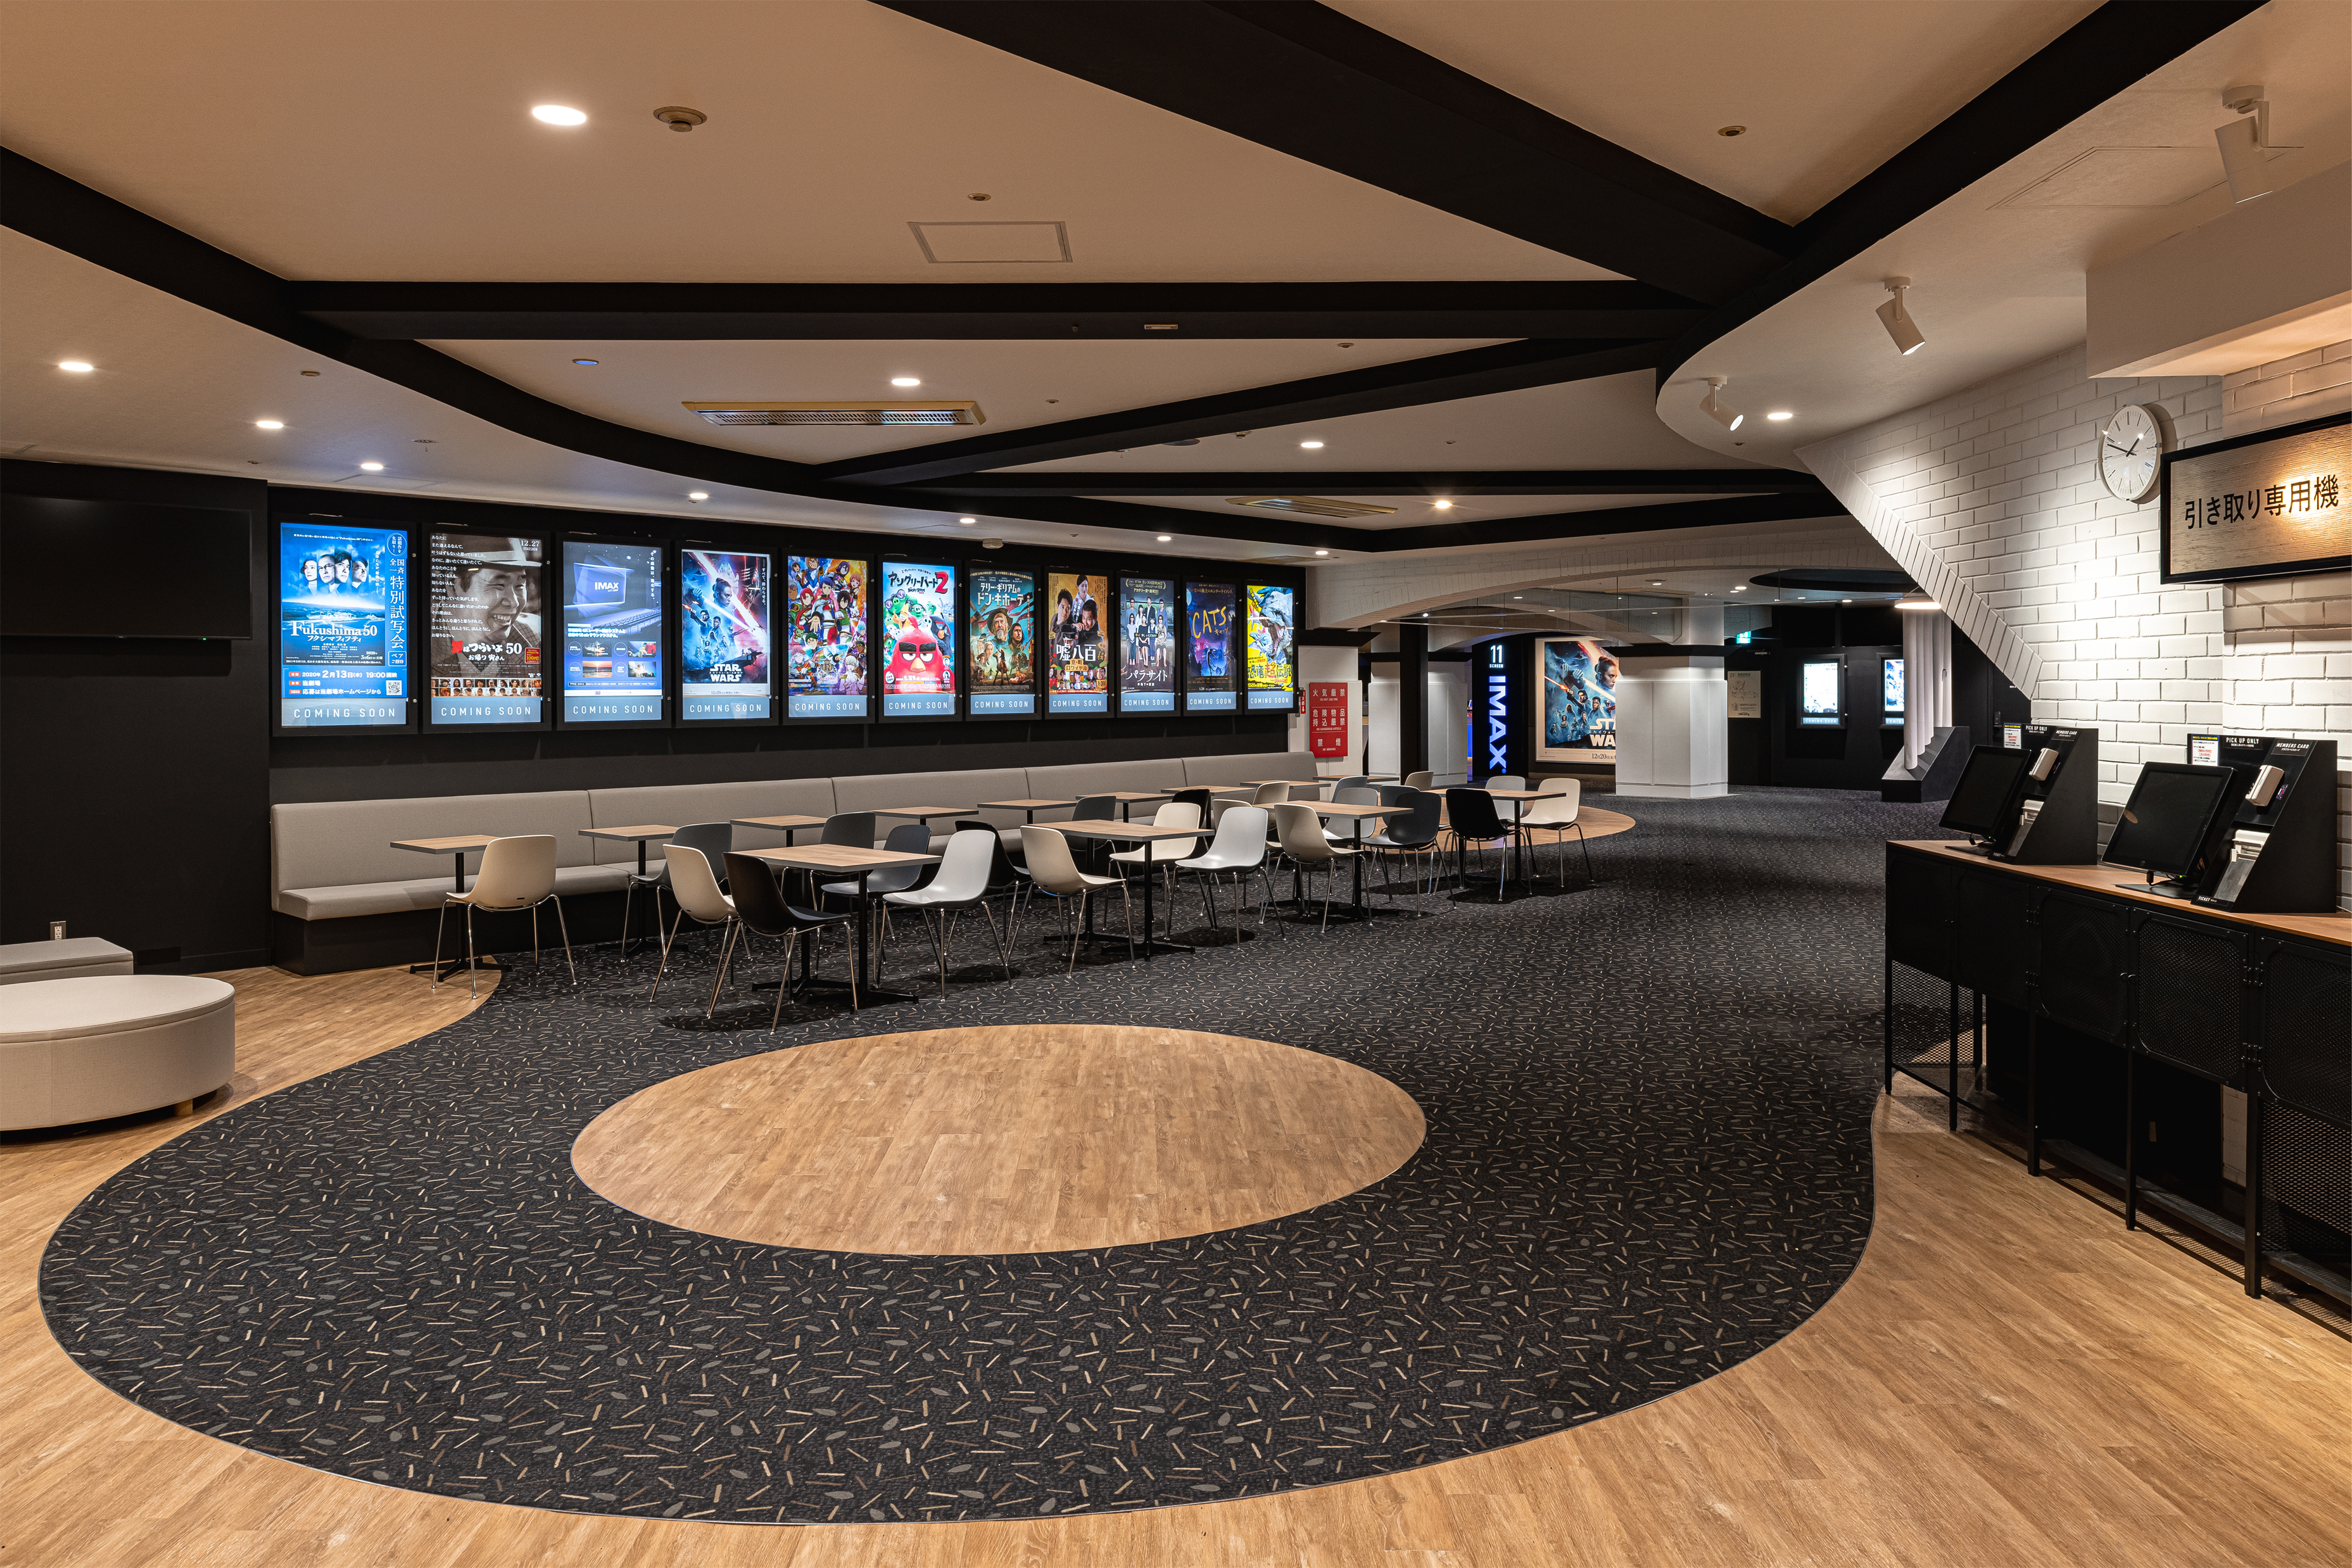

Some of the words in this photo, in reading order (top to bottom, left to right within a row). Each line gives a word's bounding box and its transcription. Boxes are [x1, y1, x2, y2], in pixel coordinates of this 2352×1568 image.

[2184, 474, 2339, 530] 引き取り専用機
[595, 581, 619, 590] IMAX
[935, 571, 949, 594] 2
[980, 583, 1021, 593] テリー・ギリアムの
[977, 592, 1024, 606] ドン・キホーテ
[389, 575, 405, 649] 特別試写会
[291, 620, 362, 636] Fukushima
[363, 624, 377, 636] 50
[1192, 606, 1227, 639] CATS
[1214, 627, 1229, 636] キャッツ
[450, 640, 503, 654] 男はつらいよ
[506, 642, 522, 654] 50
[1056, 643, 1097, 662] 嘘八百
[1490, 645, 1502, 663] 11
[710, 663, 742, 671] STAR
[710, 674, 742, 682] WARS
[1125, 669, 1168, 682] パラサイト
[1313, 688, 1346, 697] 火気厳禁
[294, 709, 350, 718] COMING
[360, 708, 395, 718] SOON
[441, 707, 491, 716] COMING
[499, 707, 531, 715] SOON
[573, 705, 617, 714] COMING
[624, 705, 653, 713] SOON
[690, 704, 730, 712] COMING
[1313, 709, 1346, 718] 危険物品
[1313, 718, 1346, 726] 持込厳禁
[1489, 676, 1506, 769] IMAX
[1590, 718, 1615, 730] ST
[1590, 735, 1615, 747] WA
